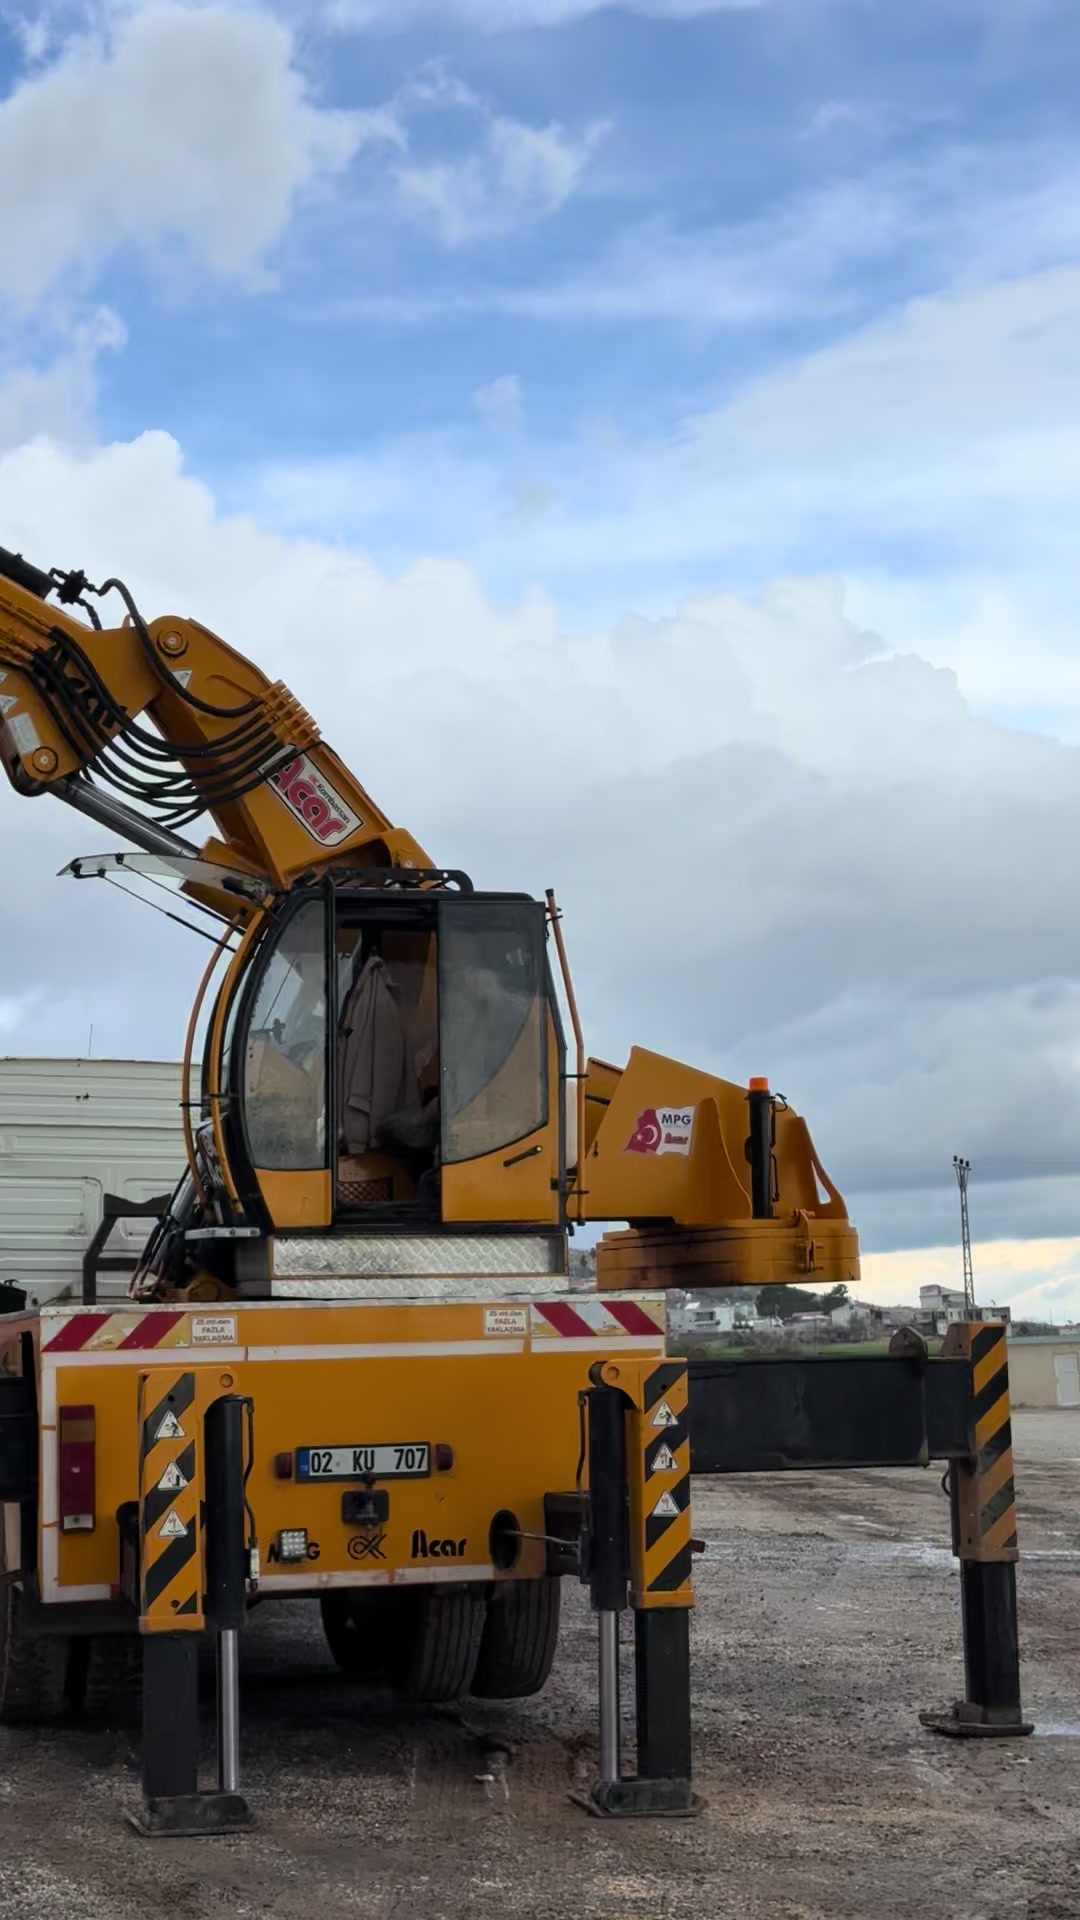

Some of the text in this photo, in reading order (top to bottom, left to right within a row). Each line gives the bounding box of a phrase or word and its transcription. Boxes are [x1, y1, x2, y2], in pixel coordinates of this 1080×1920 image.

[270, 755, 347, 840] Acar
[661, 1113, 692, 1125] MPG
[202, 1326, 226, 1334] FAZLA
[311, 1452, 333, 1474] 02
[353, 1449, 375, 1472] KU
[394, 1447, 426, 1470] 707
[267, 1541, 321, 1563] MG
[411, 1528, 467, 1559] Acar
